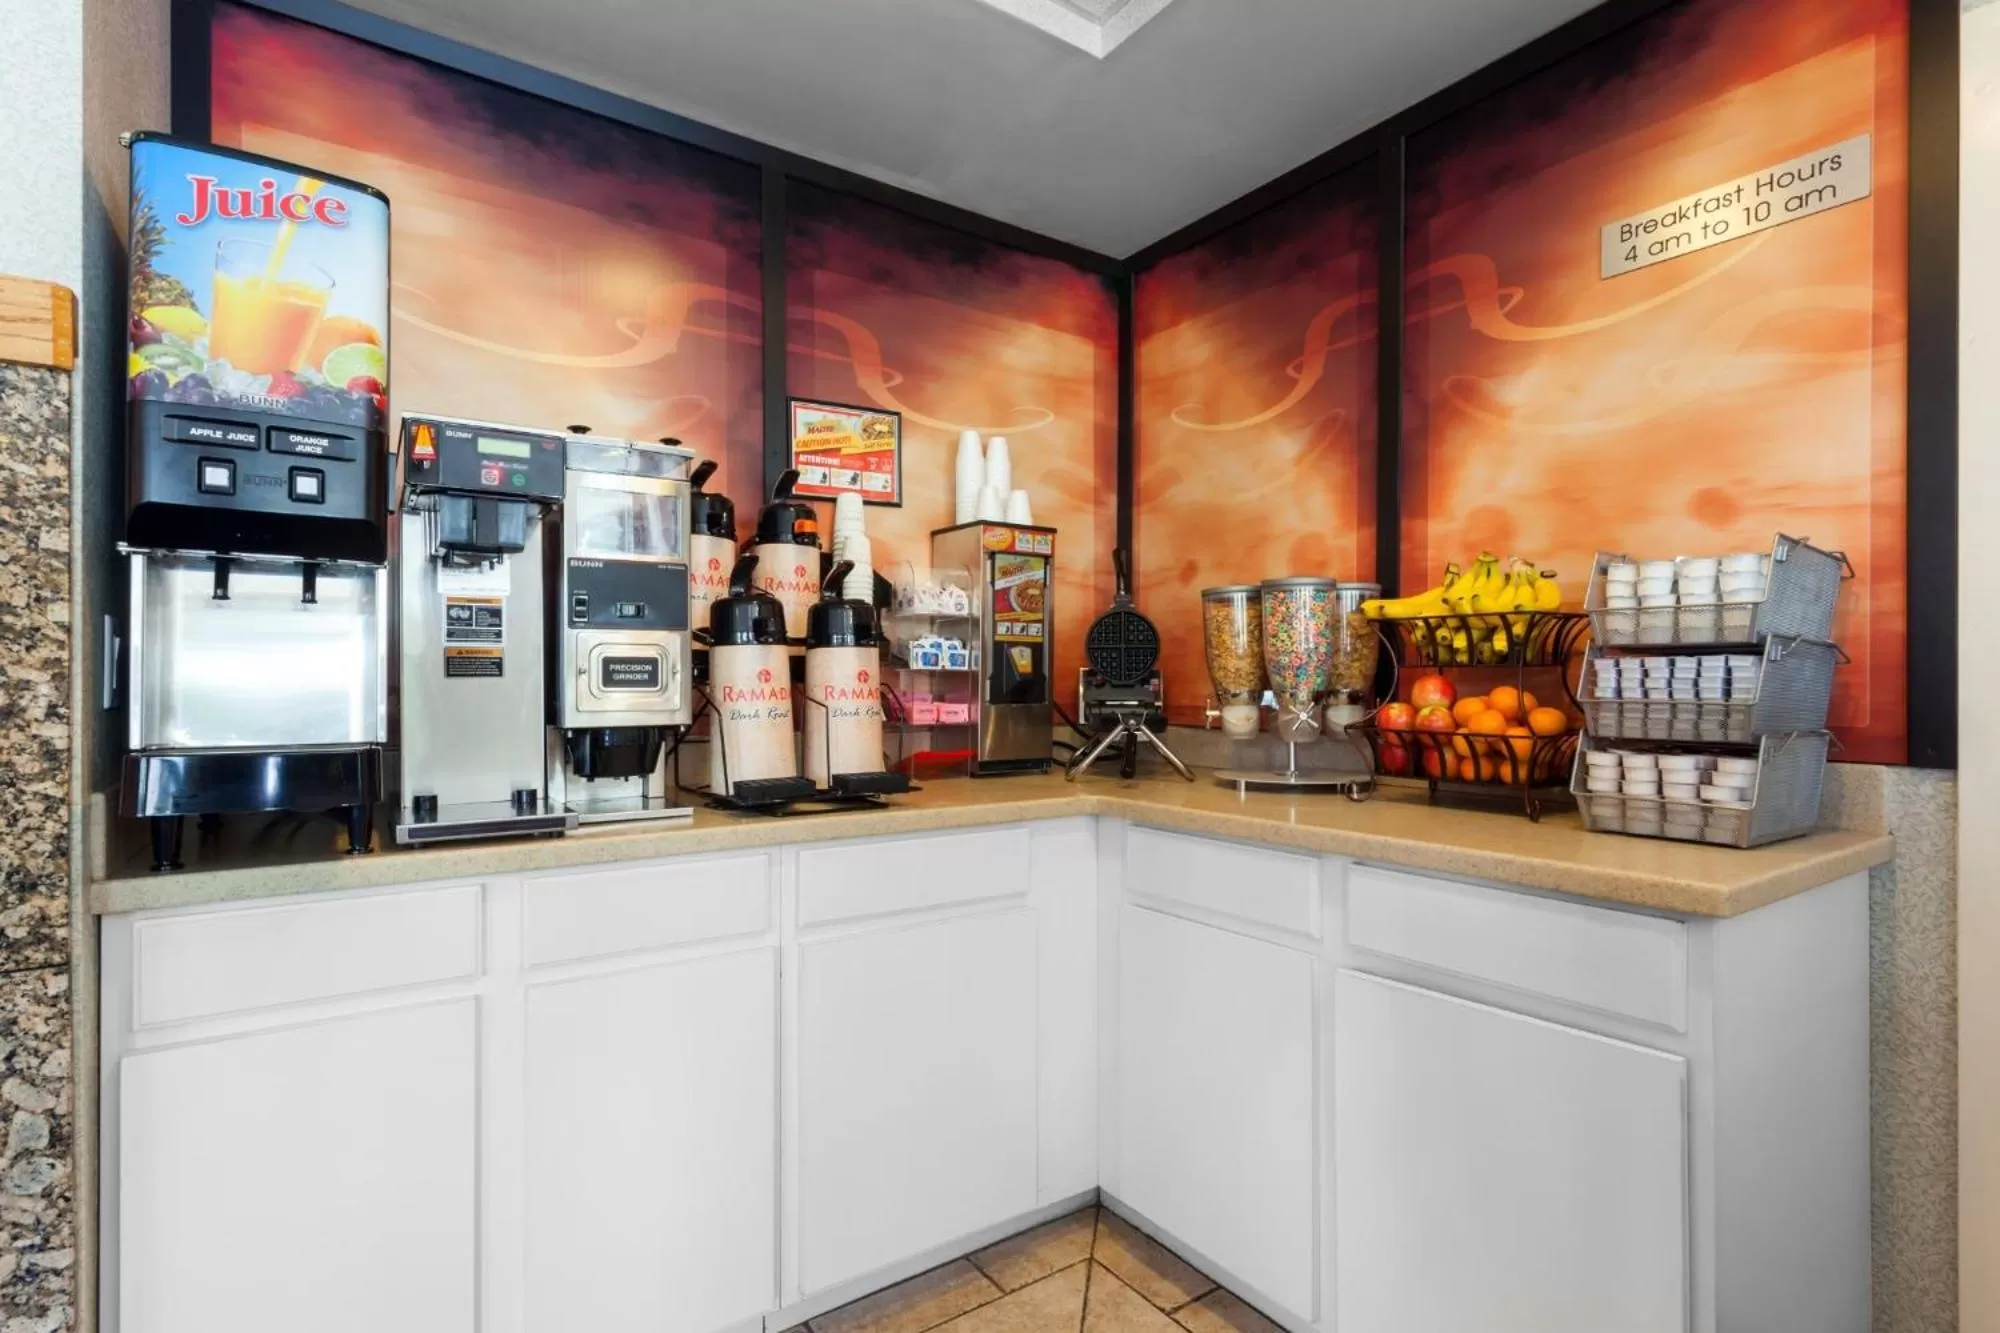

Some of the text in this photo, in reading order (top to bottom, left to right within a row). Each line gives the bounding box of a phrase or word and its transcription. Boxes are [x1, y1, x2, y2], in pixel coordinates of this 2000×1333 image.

[176, 173, 349, 228] Juice
[1619, 153, 1843, 243] Breakfast Hours
[1624, 183, 1837, 264] 4 am to 10 am
[239, 394, 288, 409] BUNN
[189, 427, 256, 442] APPLE JUICE
[289, 434, 329, 446] ORANGE
[295, 444, 323, 454] JUICE
[570, 560, 604, 568] BUNN
[608, 664, 653, 672] PRECISION
[612, 672, 649, 681] GRINDER
